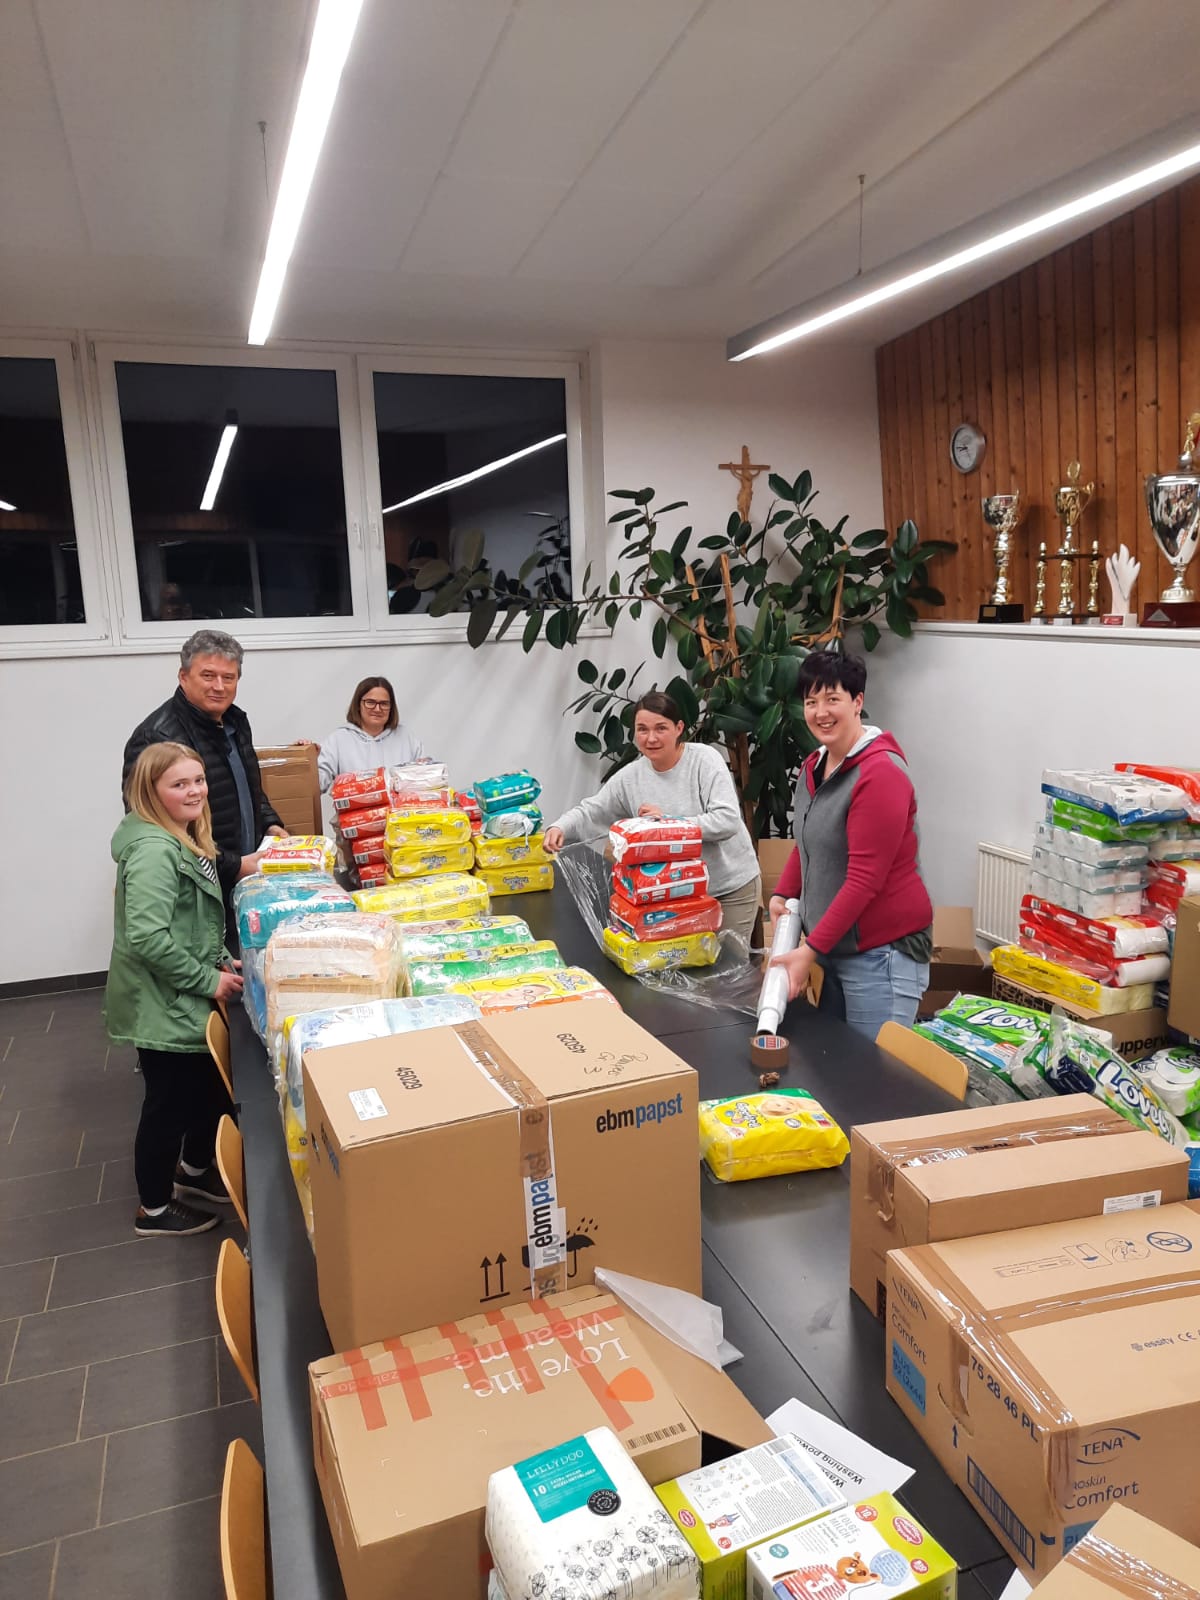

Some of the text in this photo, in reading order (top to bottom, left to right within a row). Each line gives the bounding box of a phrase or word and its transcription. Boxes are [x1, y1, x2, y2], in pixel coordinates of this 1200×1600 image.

[556, 1032, 587, 1054] 45029
[394, 1066, 423, 1090] 45029
[596, 1092, 683, 1133] ebmpapst
[522, 1311, 614, 1347] Wear
[891, 1313, 927, 1365] Comfort
[1143, 1336, 1175, 1348] essity
[463, 1336, 632, 1399] Love me.
[336, 1369, 400, 1393] zaldo
[970, 1355, 1039, 1443] 75 28 46 PL
[1081, 1437, 1124, 1457] TENA
[821, 1454, 863, 1485] Washing
[532, 1484, 547, 1497] 10
[830, 1517, 852, 1541] MILCH
